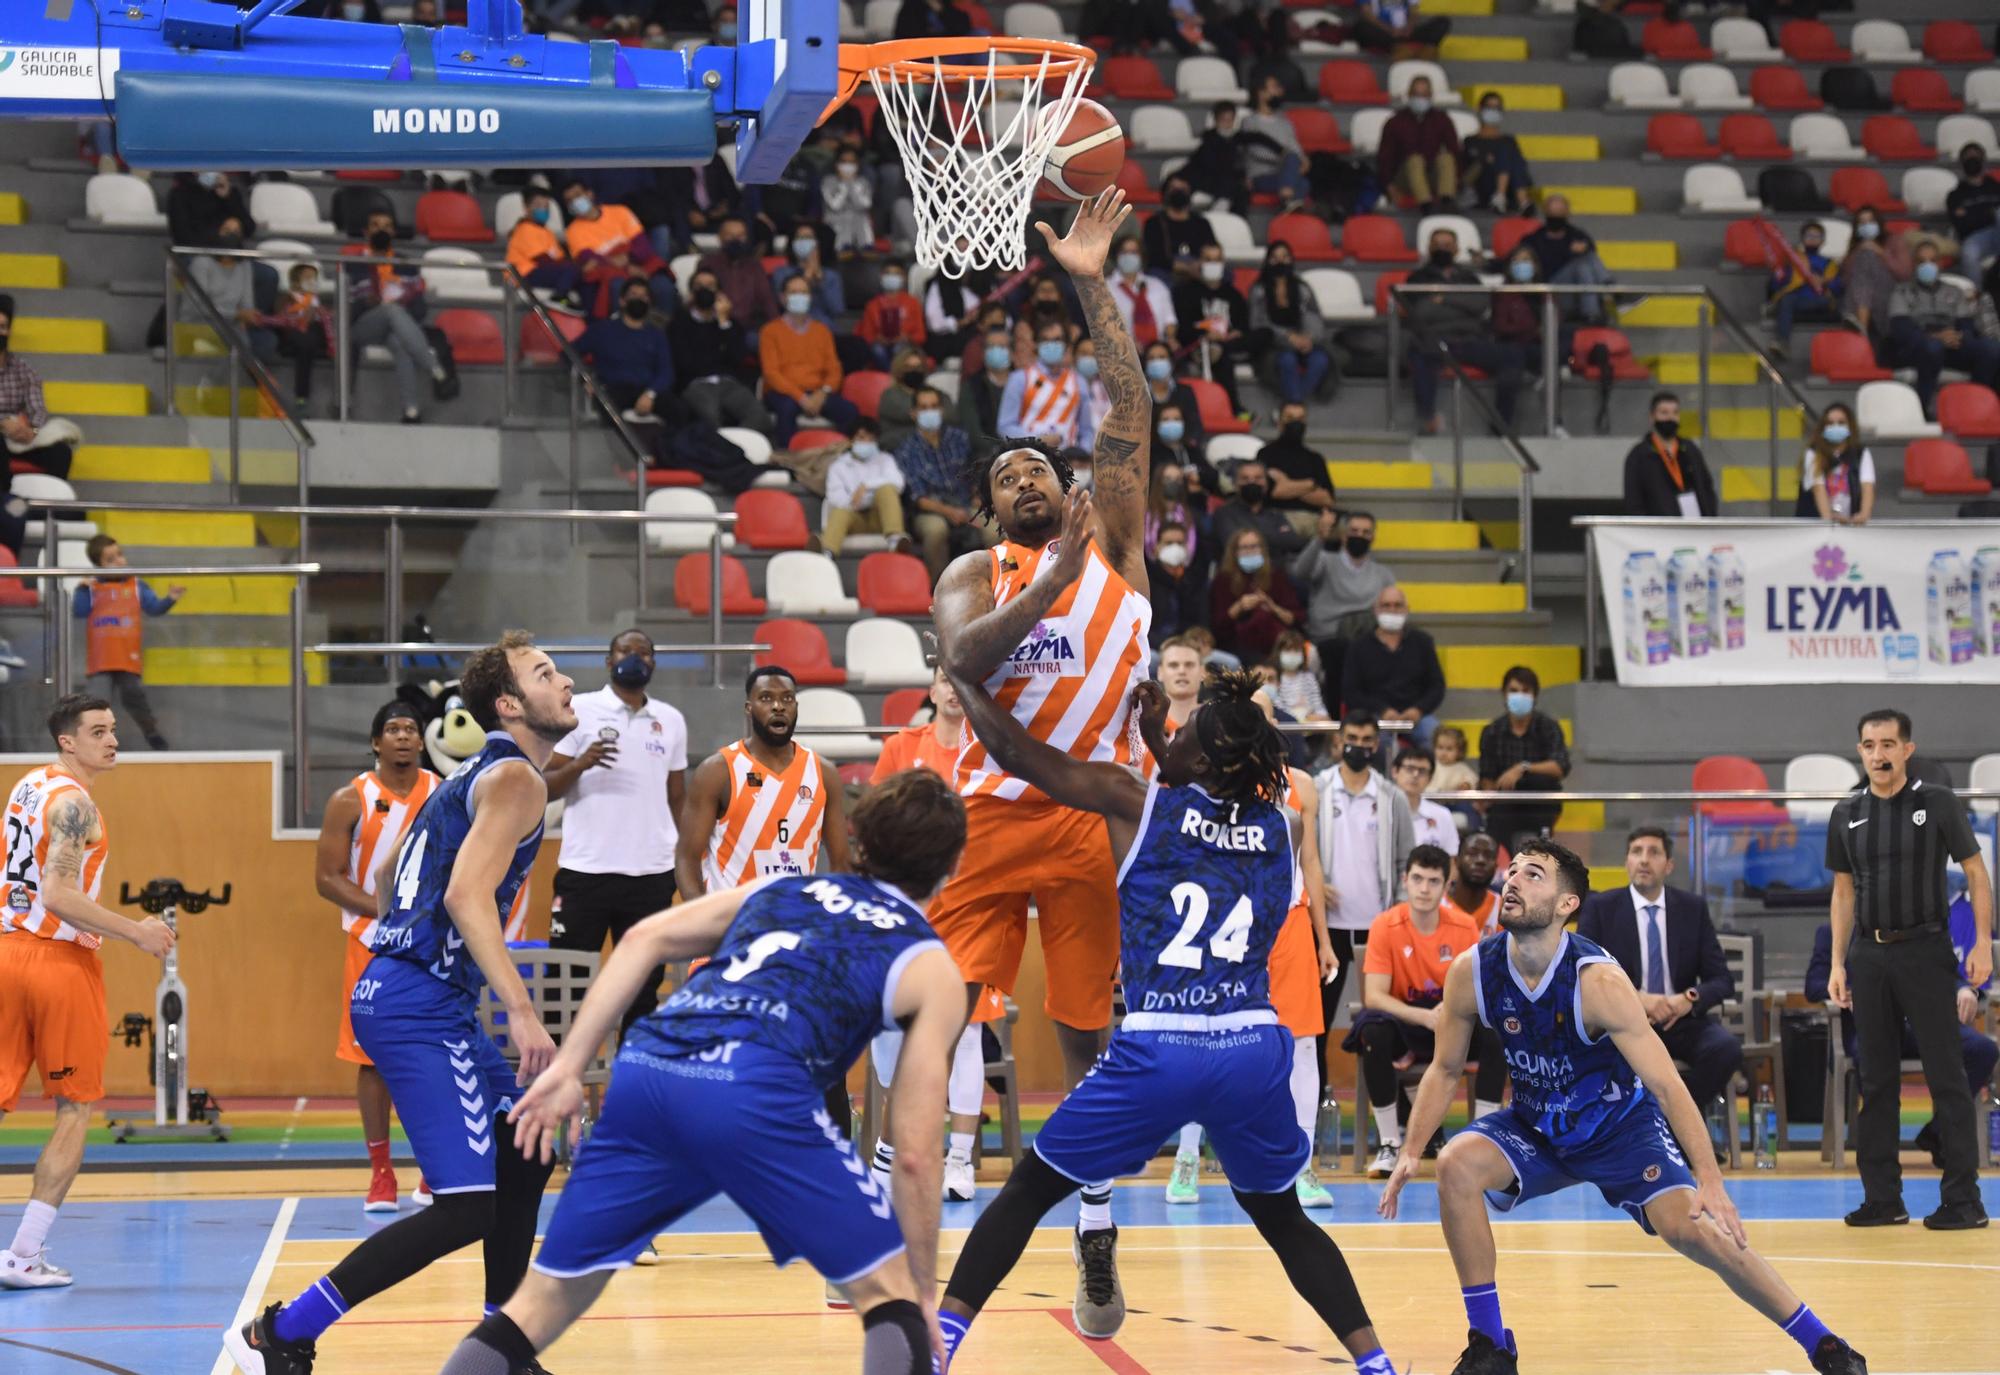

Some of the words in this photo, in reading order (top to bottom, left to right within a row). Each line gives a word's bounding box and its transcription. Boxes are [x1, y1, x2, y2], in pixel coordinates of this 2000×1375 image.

[21, 50, 77, 63] GALICIA
[21, 64, 94, 77] SAUDABLE
[373, 108, 500, 133] MONDO
[1766, 586, 1901, 632] LEYMA
[1788, 635, 1877, 659] NATURA
[1013, 662, 1062, 675] NATURA
[777, 819, 788, 844] 6
[7, 816, 37, 891] 22
[1158, 882, 1254, 970] 24
